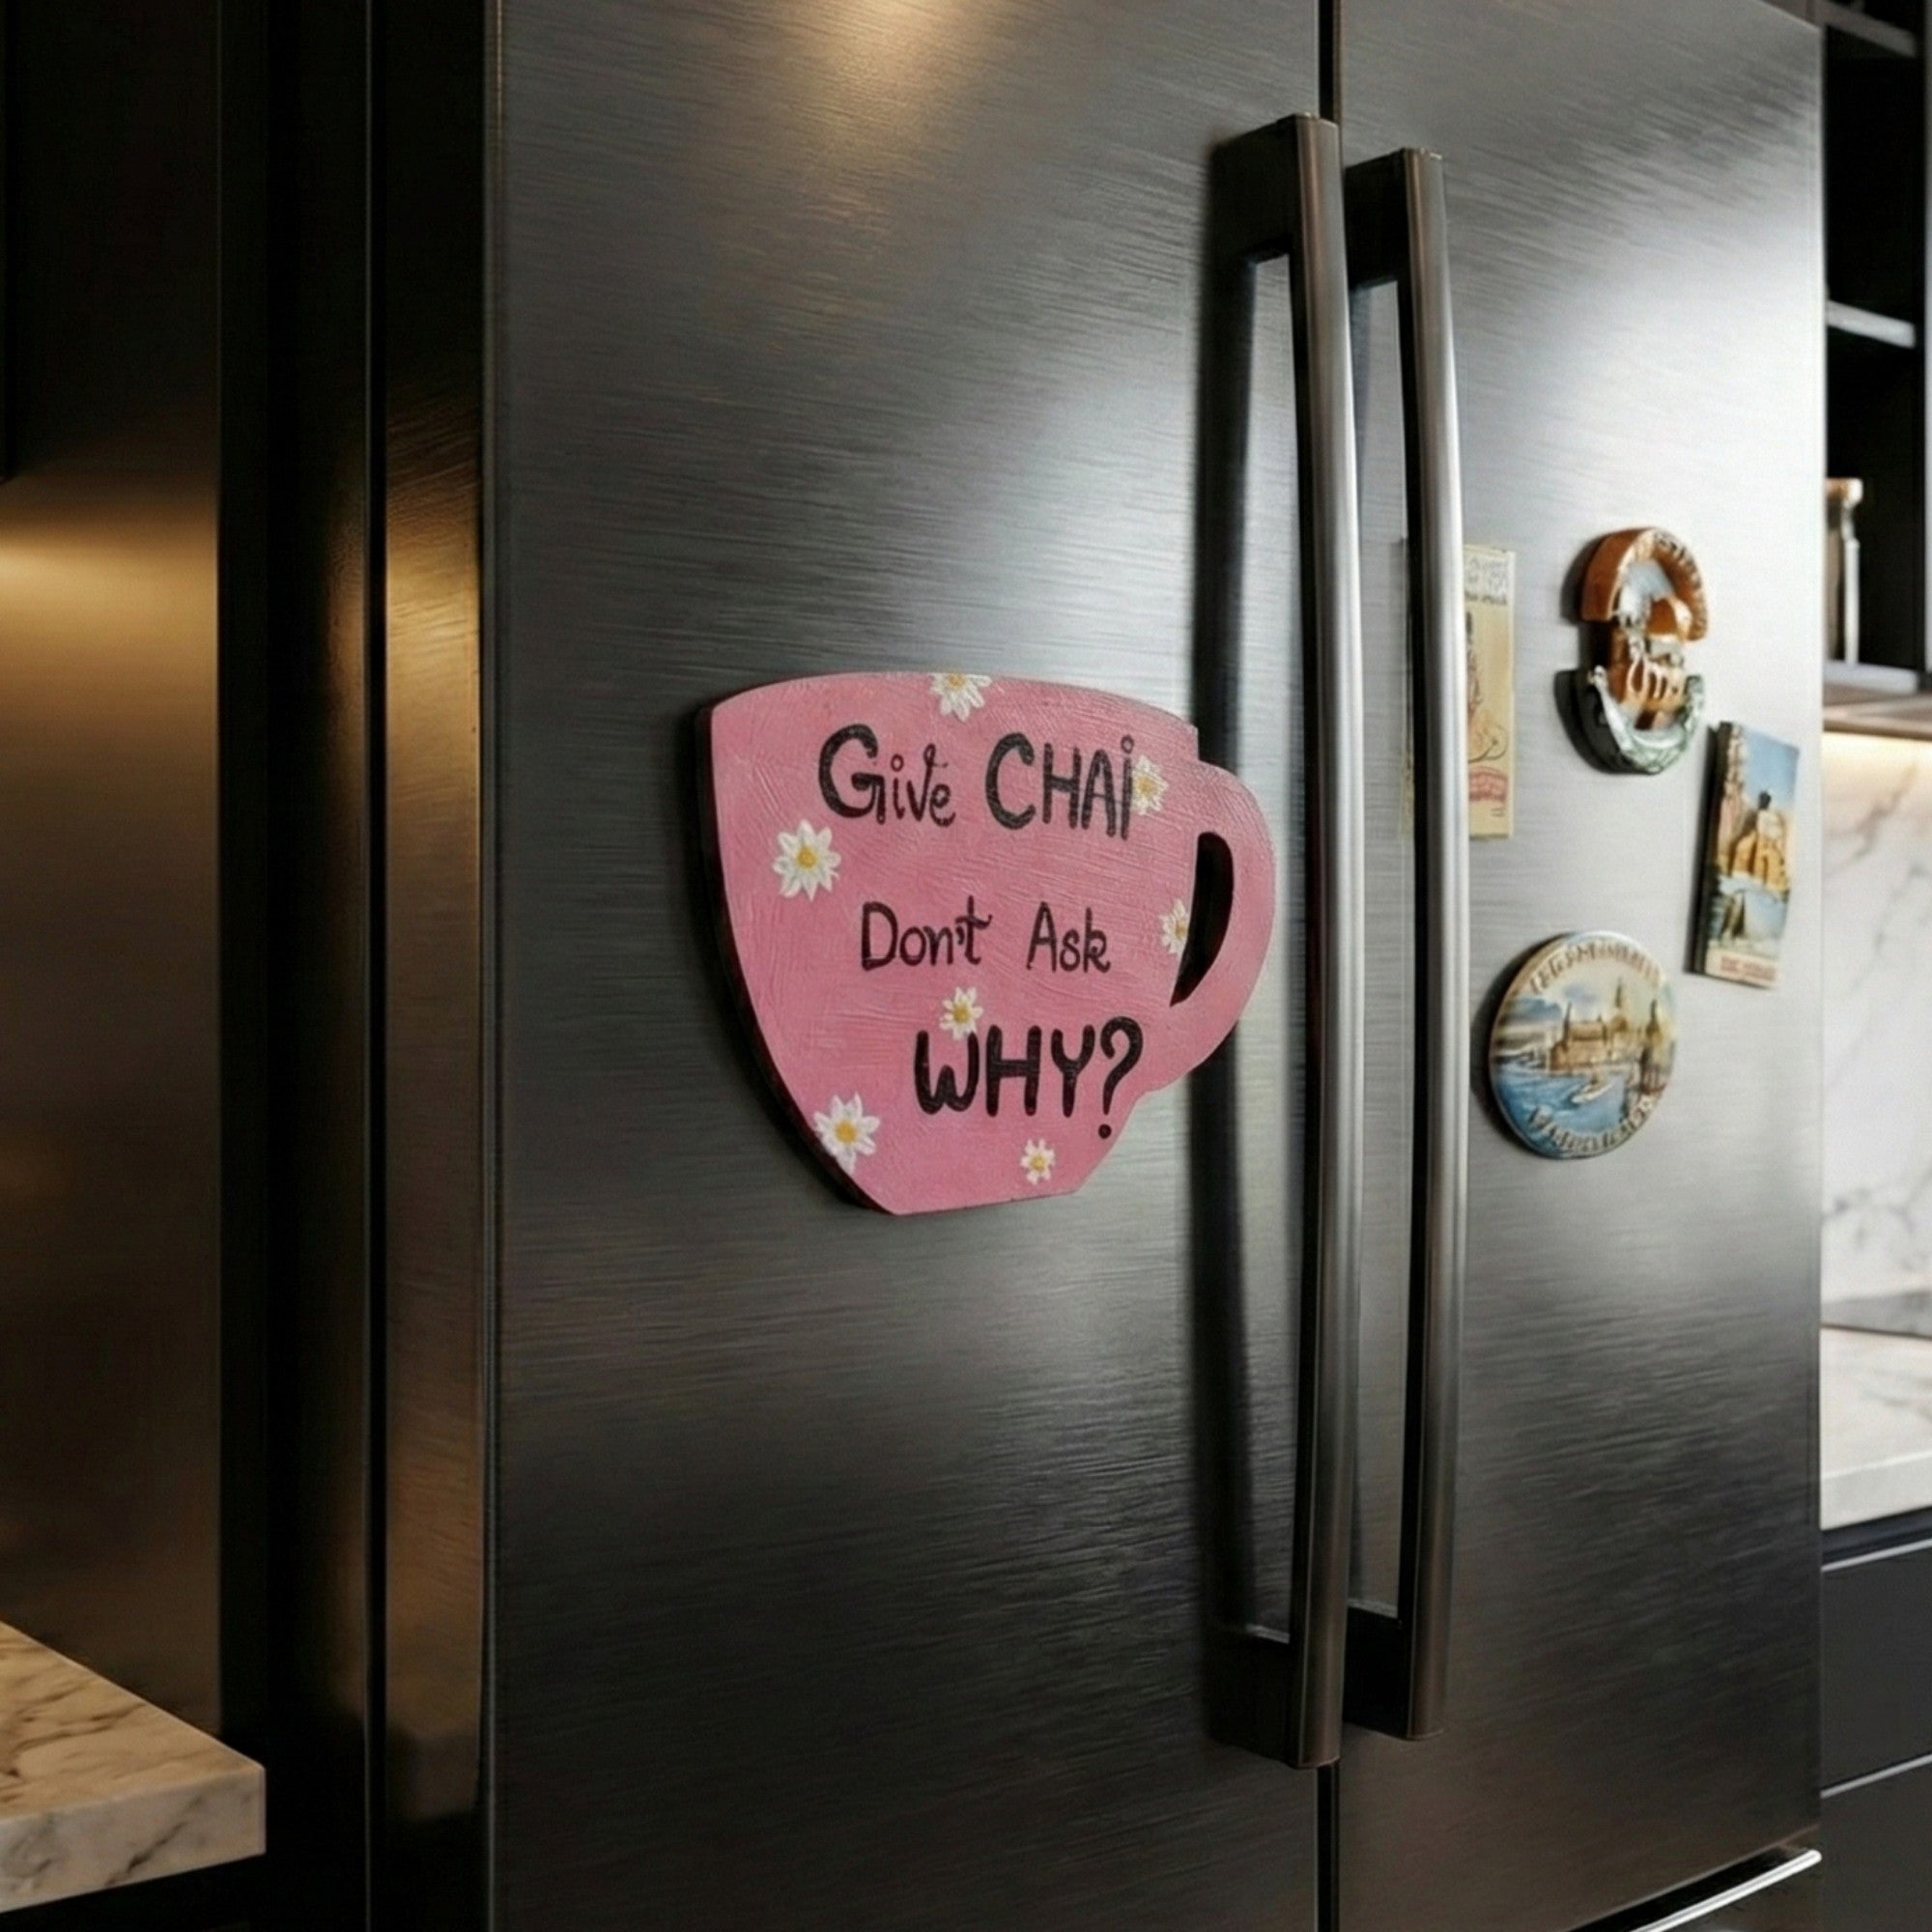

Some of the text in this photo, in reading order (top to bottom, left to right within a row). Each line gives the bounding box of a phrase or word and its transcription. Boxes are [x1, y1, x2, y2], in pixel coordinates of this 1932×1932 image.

[818, 724, 955, 827] Give
[861, 895, 1111, 973] Don't Ask
[914, 1016, 1144, 1139] WHY?
